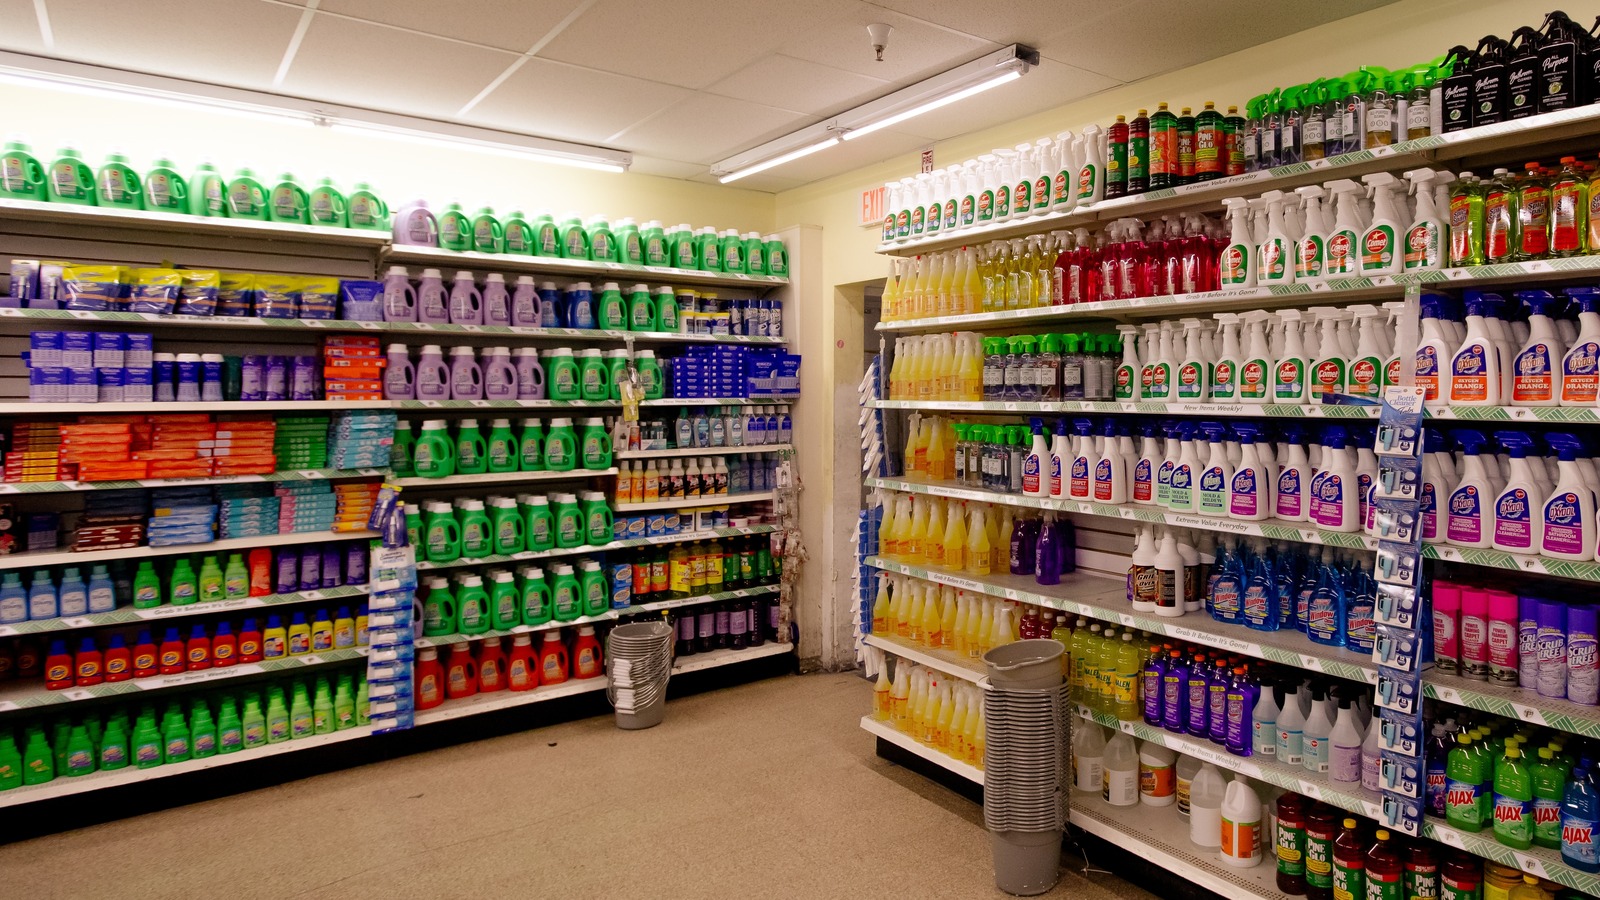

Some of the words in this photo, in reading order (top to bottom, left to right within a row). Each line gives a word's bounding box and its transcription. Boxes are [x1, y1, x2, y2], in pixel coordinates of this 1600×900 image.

[1542, 56, 1568, 72] Purpose
[1198, 132, 1214, 140] PINE
[1185, 182, 1210, 191] Extreme
[1211, 178, 1228, 187] Value
[1229, 173, 1258, 186] Everyday
[862, 186, 885, 223] EXIT
[1416, 358, 1434, 370] XYDOL
[1456, 356, 1482, 372] OXYDOL
[1520, 357, 1546, 372] OXYDOL
[1570, 356, 1596, 372] OXYDOL
[1182, 371, 1198, 380] Comet
[1245, 370, 1262, 379] Comet
[1280, 370, 1298, 379] Comet
[1318, 370, 1338, 378] Comet
[1354, 368, 1374, 378] Comet
[1217, 404, 1243, 412] Weekly!
[1452, 496, 1476, 514] OXYDOL
[1500, 502, 1524, 519] OXYDOL
[1550, 505, 1576, 522] OXYDOL
[1175, 516, 1200, 524] Extreme
[1201, 518, 1217, 526] Value
[1218, 521, 1248, 532] Everyday
[1214, 592, 1238, 602] Window
[1245, 598, 1266, 608] Window
[1310, 610, 1334, 621] Window
[1348, 619, 1374, 630] Window
[1176, 628, 1192, 636] Grab
[1199, 632, 1218, 644] Before
[1229, 639, 1250, 650] Gone!
[1538, 638, 1564, 652] SCRUB
[1540, 648, 1560, 658] FREE
[1568, 644, 1596, 658] SCRUB
[1572, 654, 1593, 666] FREE
[1182, 742, 1194, 752] New
[1196, 748, 1214, 759] Items
[1216, 754, 1241, 768] Weekly!
[1427, 774, 1446, 786] AJAX
[1448, 790, 1474, 805] AJAX
[1495, 806, 1523, 823] AJAX
[1532, 806, 1561, 825] AJAX
[1279, 826, 1296, 841] PINE
[1562, 827, 1592, 844] AJAX
[1280, 838, 1296, 850] GLO
[1308, 838, 1325, 853] PINE
[1310, 849, 1325, 862] GLO
[1415, 874, 1435, 887] PINE
[1418, 886, 1436, 897] GLO
